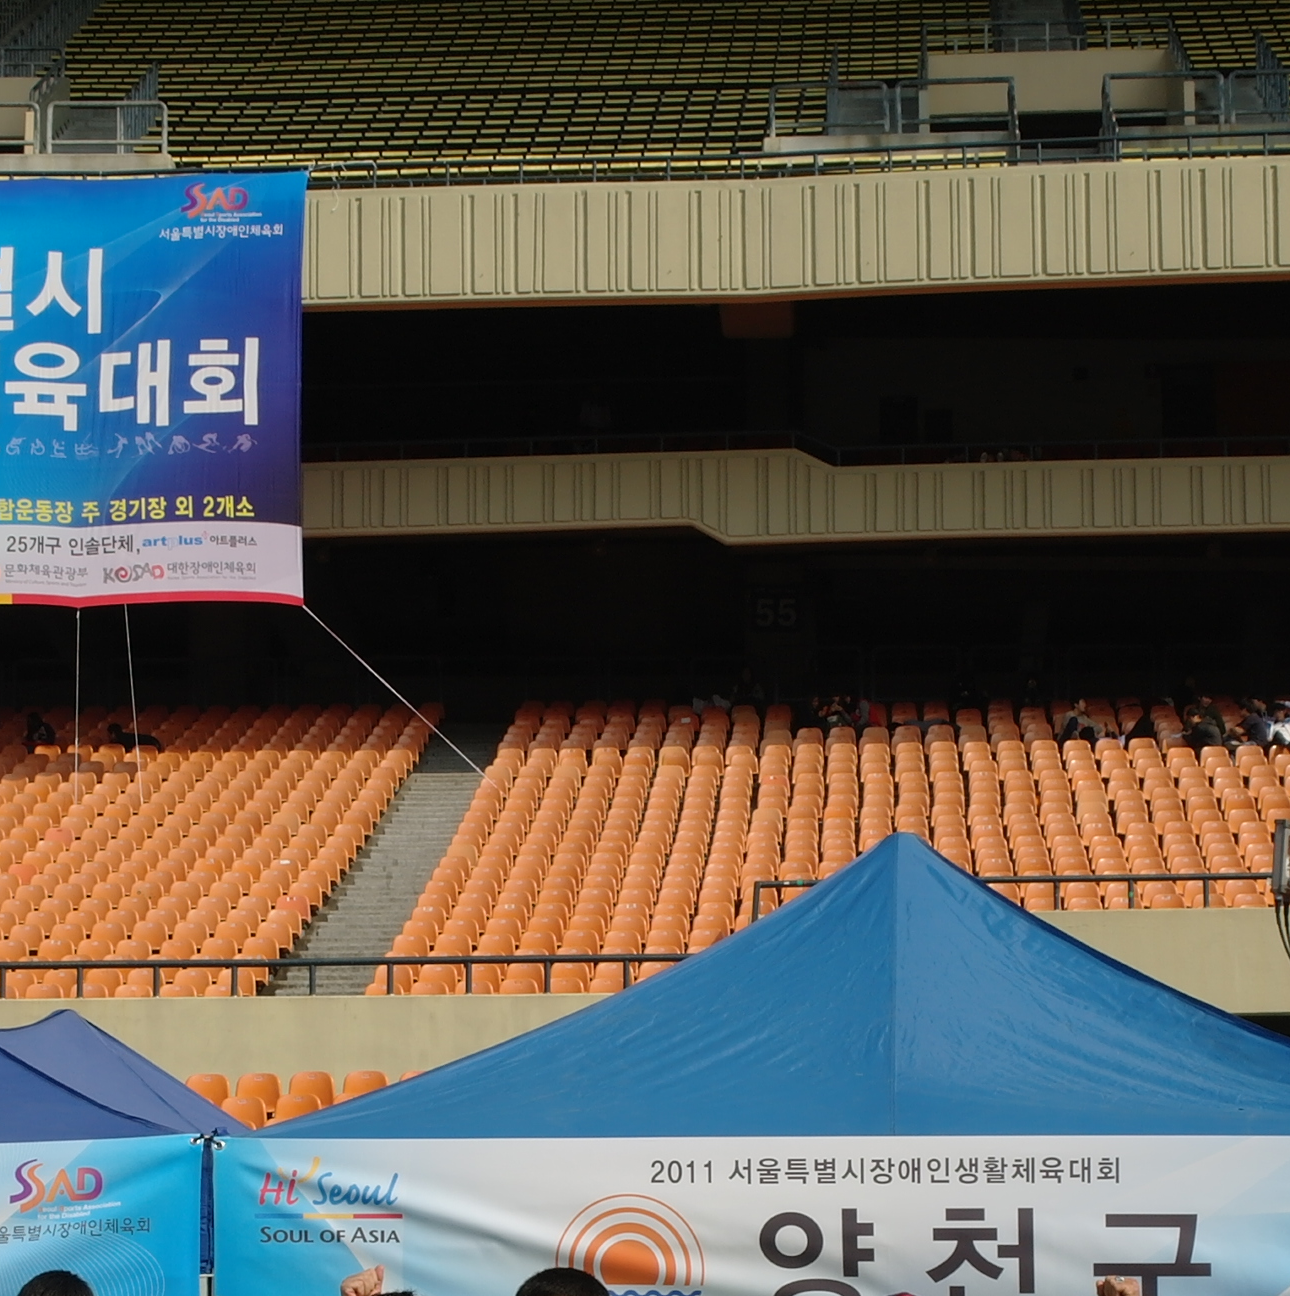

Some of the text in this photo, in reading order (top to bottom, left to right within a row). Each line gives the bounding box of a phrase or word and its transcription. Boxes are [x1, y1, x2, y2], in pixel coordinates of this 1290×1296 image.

[159, 224, 284, 241] 서울특별시장애인체육회
[81, 501, 101, 523] 주
[109, 496, 167, 521] 경기장
[175, 496, 193, 518] 외
[203, 495, 255, 518] 2개소
[6, 536, 61, 553] 25개구
[68, 534, 140, 556] 인솔단체,
[210, 535, 257, 547] 아트플러스
[4, 562, 89, 582] 문화체육관광부
[167, 561, 256, 575] 대한장애인체육회
[756, 597, 797, 628] 55
[650, 1156, 1120, 1184] 2011 서울특별시장애인생활체육대회
[10, 1159, 103, 1213] SSAD
[259, 1171, 399, 1206] Hi Seoul
[260, 1225, 400, 1244] SOUL OF ASIA
